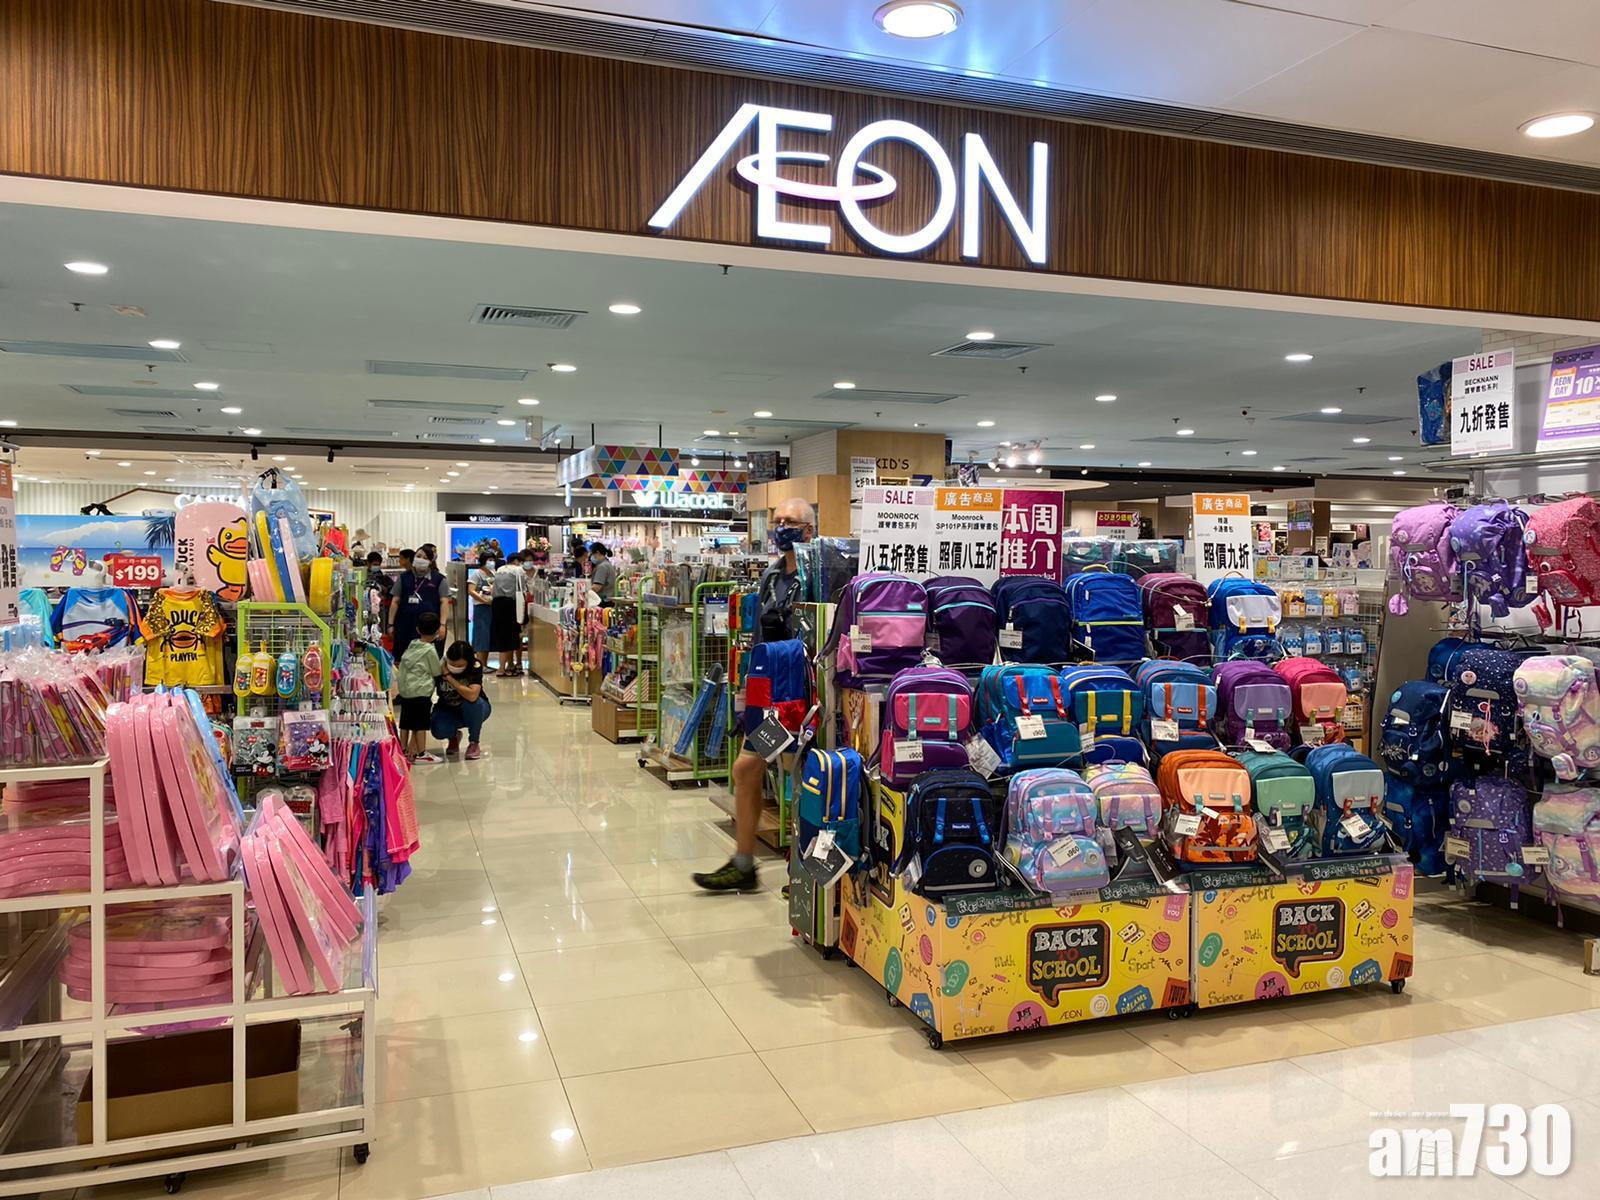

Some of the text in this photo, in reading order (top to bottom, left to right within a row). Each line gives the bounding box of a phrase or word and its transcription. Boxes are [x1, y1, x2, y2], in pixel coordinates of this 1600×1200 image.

[1469, 355, 1494, 371] SALE
[1460, 401, 1510, 434] 九折發售
[885, 490, 914, 505] SALE
[944, 492, 993, 507] 廣告商品
[1202, 497, 1242, 511] 廣告商品
[877, 512, 919, 520] MOONROCK
[1002, 504, 1058, 535] 本周
[865, 543, 928, 573] 八五折發售
[939, 541, 997, 570] 照價八五折
[1001, 538, 1057, 570] 推介
[1203, 543, 1249, 570] 照價九折
[115, 565, 159, 580] $199
[1279, 904, 1335, 926] BACK
[1035, 928, 1098, 952] BACK
[1360, 932, 1385, 947] Sport
[1128, 958, 1156, 973] Sport
